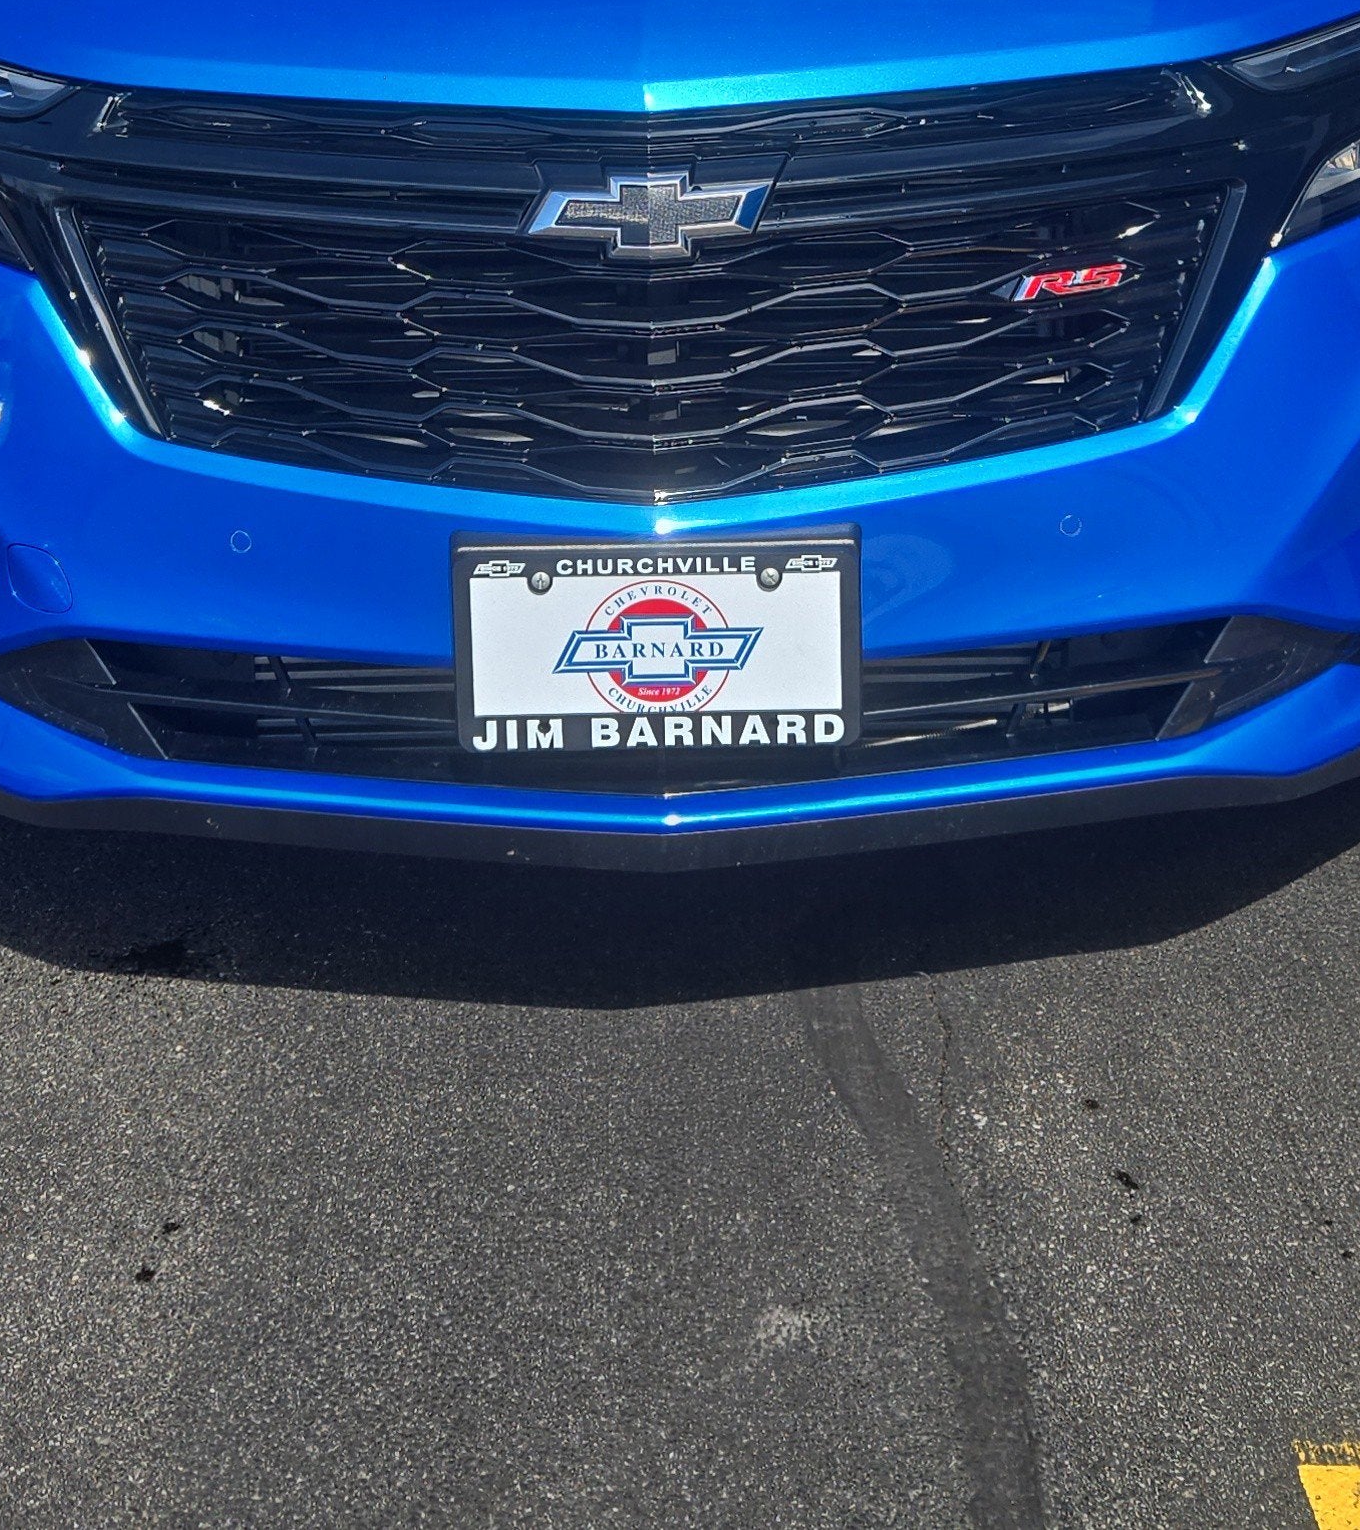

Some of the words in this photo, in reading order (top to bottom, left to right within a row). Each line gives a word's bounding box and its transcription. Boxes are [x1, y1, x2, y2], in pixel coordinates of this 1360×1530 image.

[1015, 263, 1128, 301] RS
[556, 556, 757, 575] CHURCHVILLE
[604, 585, 713, 616] CHEVROLET
[594, 641, 725, 659] BARNARD
[608, 684, 713, 712] CHURCHVILLE
[637, 686, 660, 696] Since
[473, 719, 564, 751] JIM
[591, 713, 845, 749] BARNARD
